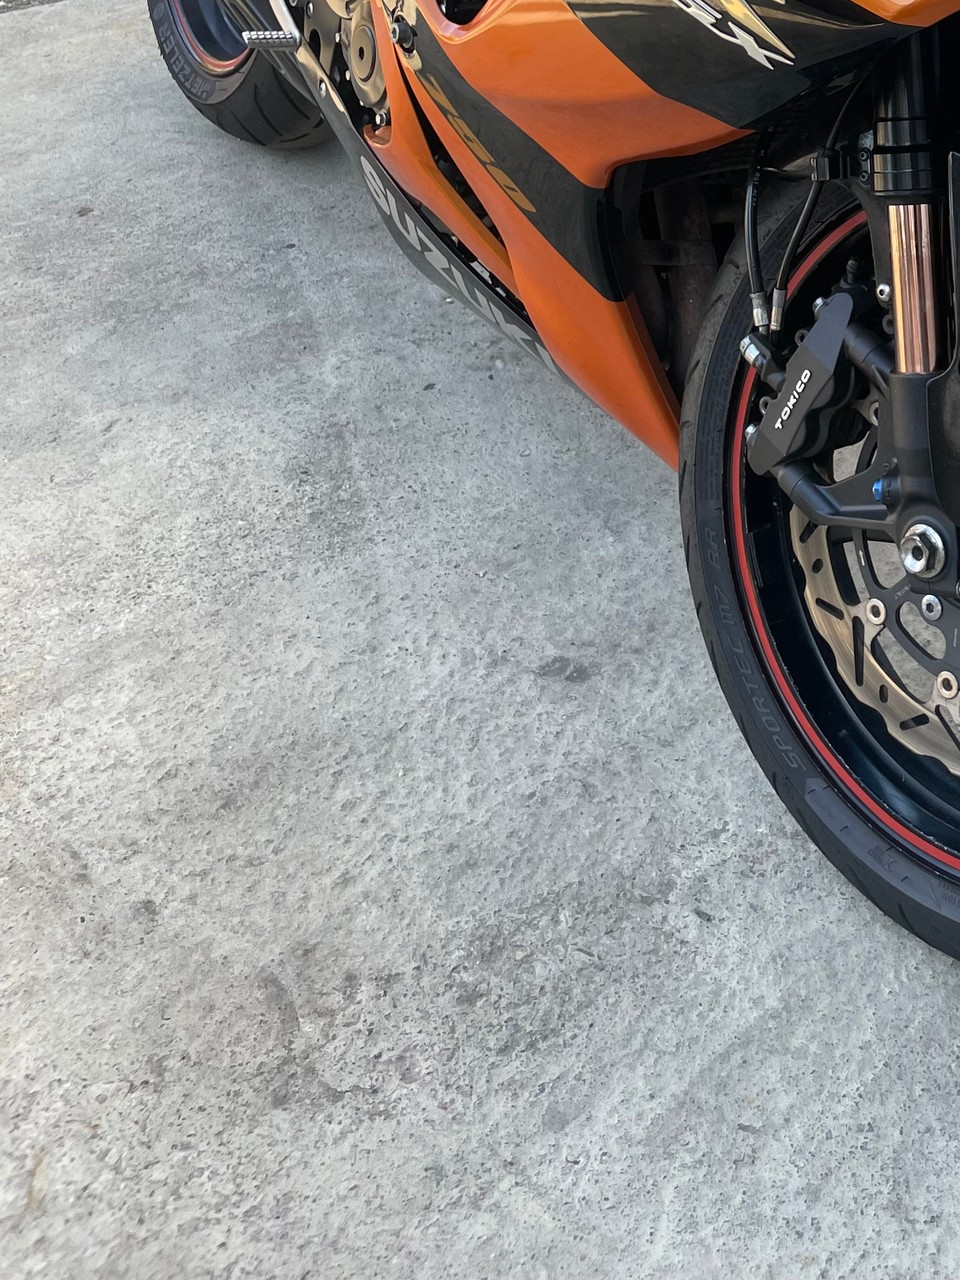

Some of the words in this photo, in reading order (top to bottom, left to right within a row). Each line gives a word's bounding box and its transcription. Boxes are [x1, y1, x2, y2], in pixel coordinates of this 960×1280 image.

[158, 21, 210, 100] METZELER
[360, 155, 559, 378] SUZUKI
[774, 369, 812, 430] TOKICO
[724, 623, 804, 771] SPORTEC
